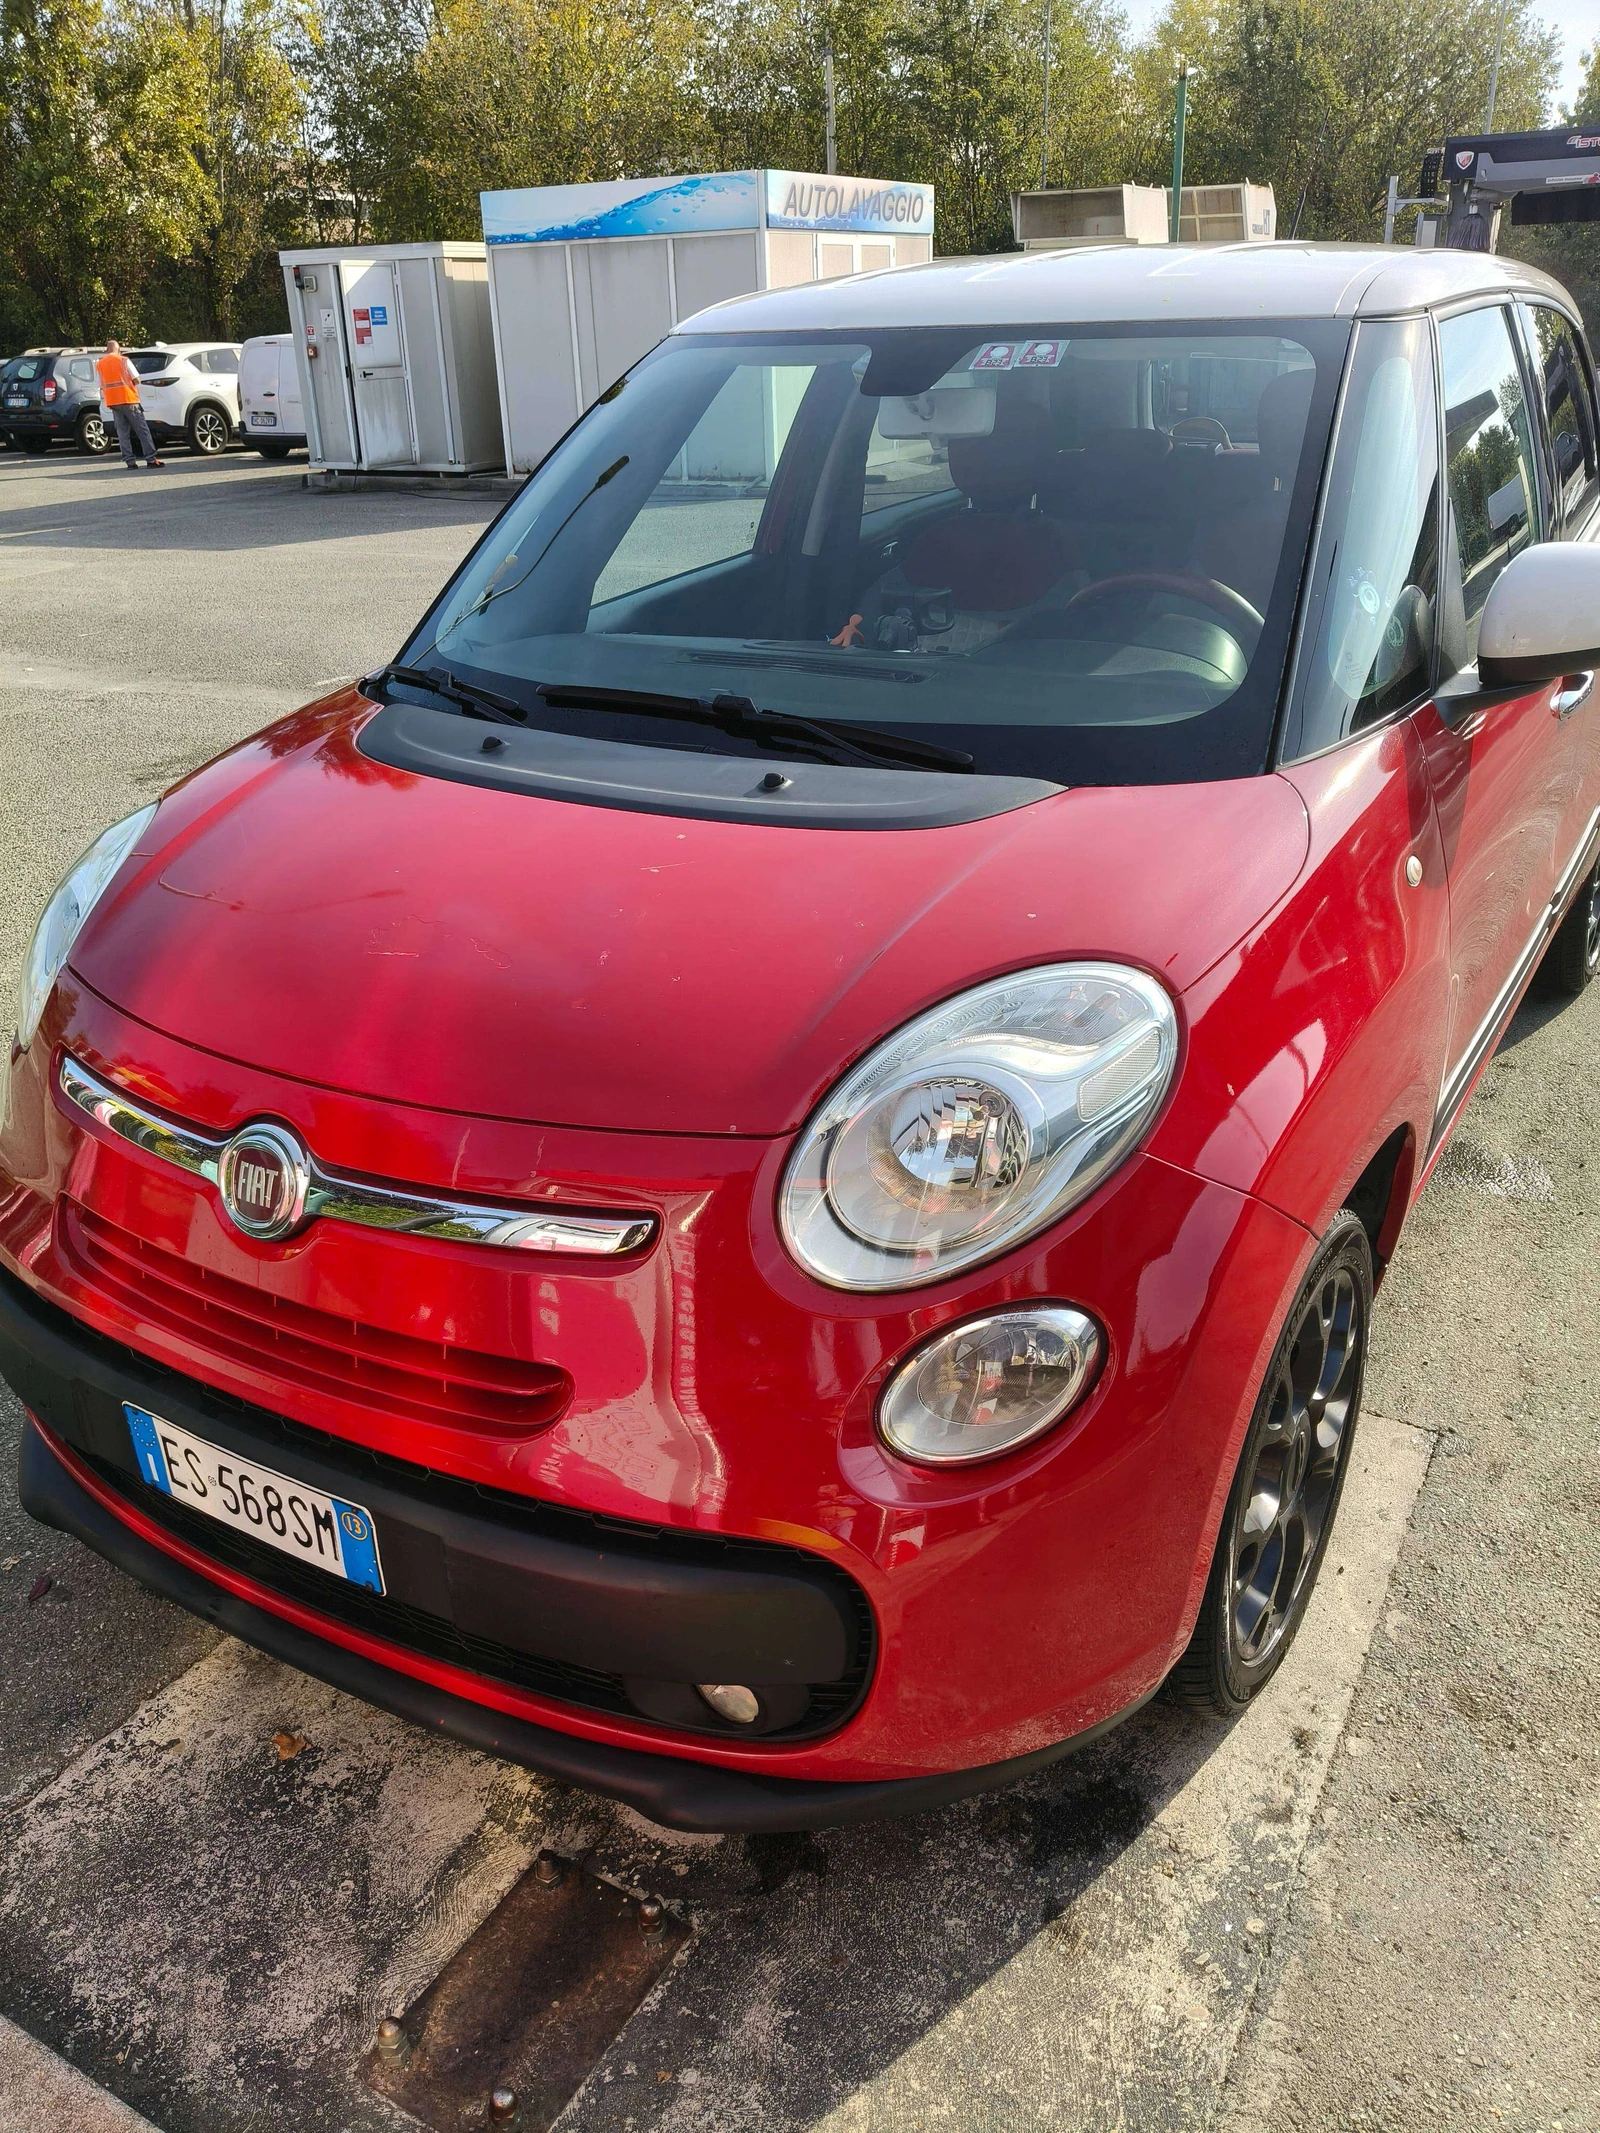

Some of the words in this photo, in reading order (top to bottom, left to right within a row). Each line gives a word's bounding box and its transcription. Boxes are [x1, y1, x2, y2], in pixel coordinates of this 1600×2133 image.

[783, 181, 924, 224] AUTOLAVAGGIO
[237, 1160, 279, 1209] FIAT
[160, 1433, 208, 1498] ES
[217, 1463, 340, 1561] 568SM
[344, 1515, 364, 1535] 13
